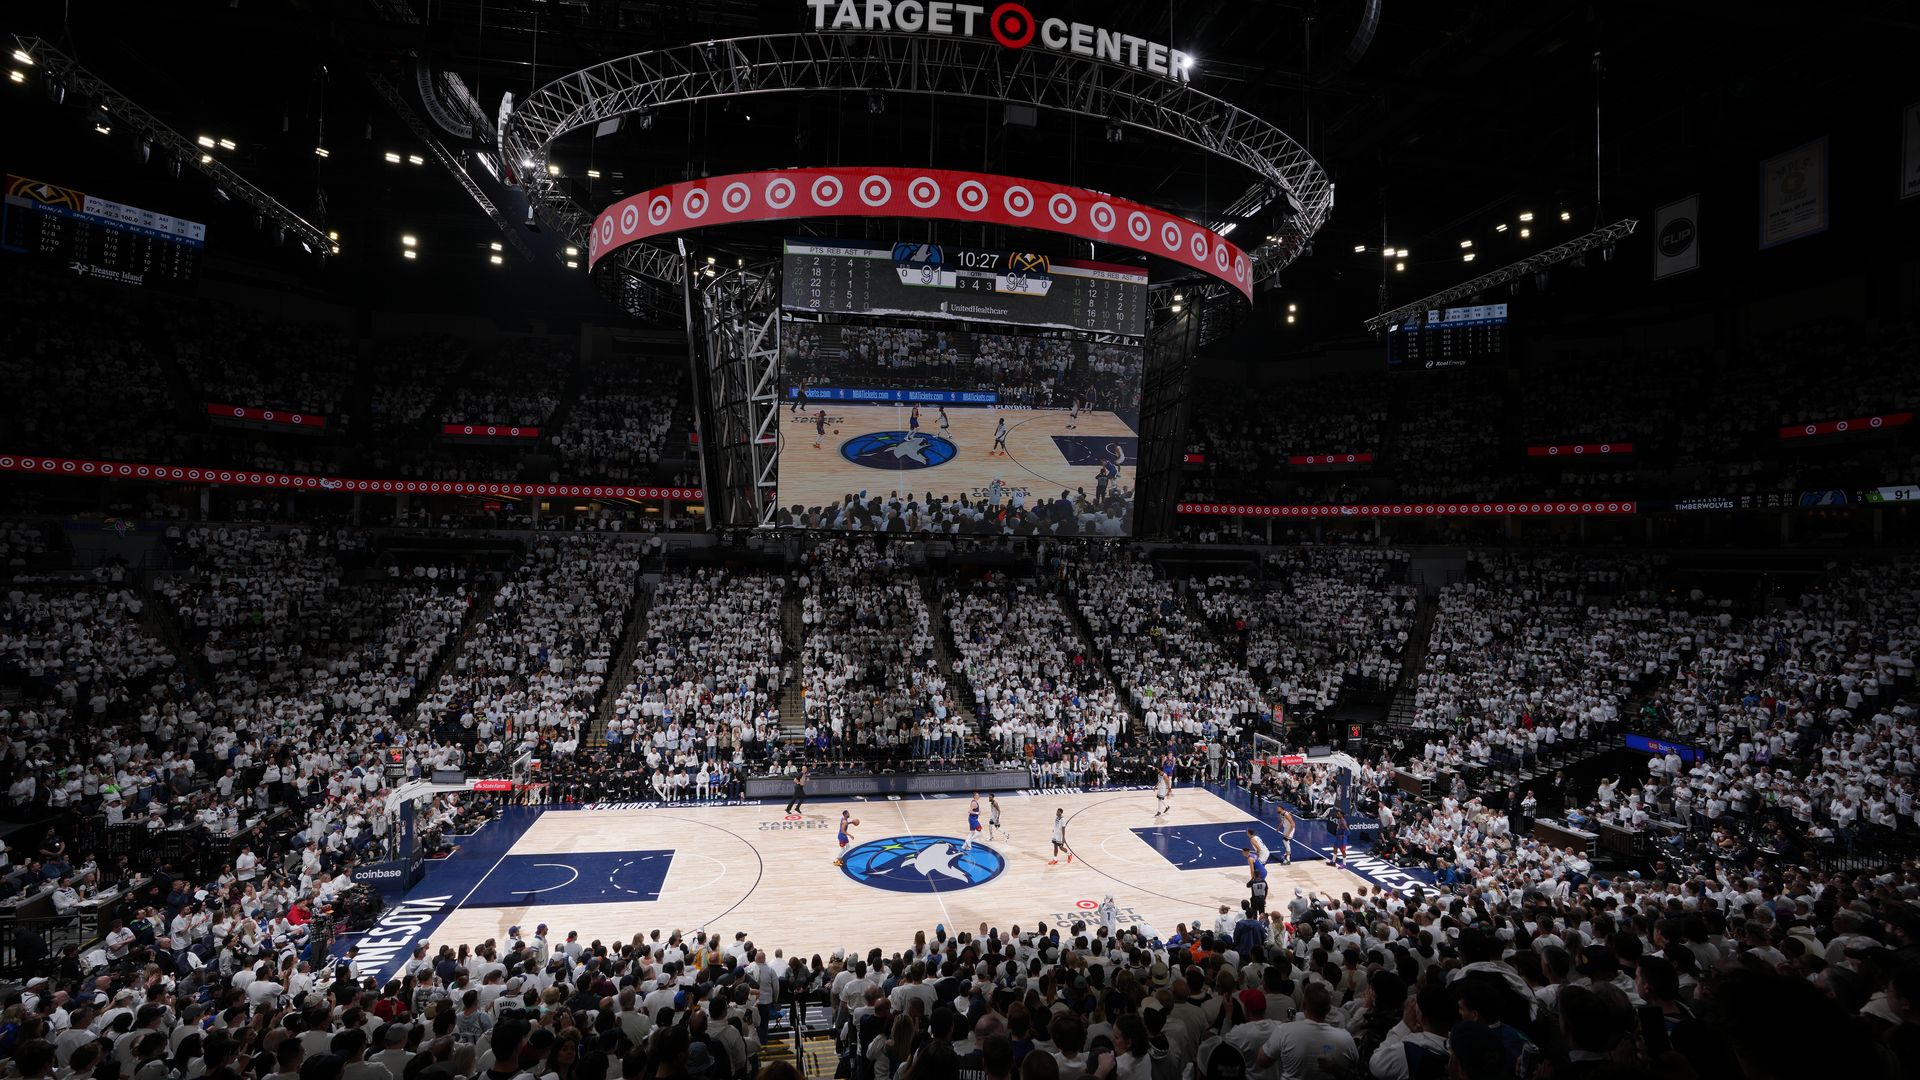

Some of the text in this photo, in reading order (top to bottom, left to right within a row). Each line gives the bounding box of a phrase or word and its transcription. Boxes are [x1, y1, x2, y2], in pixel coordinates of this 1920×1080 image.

[807, 0, 1191, 83] TARGET CENTER
[121, 215, 139, 223] 100.0
[1662, 227, 1691, 247] FLIP
[814, 257, 820, 266] 2
[830, 258, 836, 266] 2
[848, 259, 853, 267] 4
[864, 260, 871, 268] 3
[958, 251, 1000, 269] 10:27
[90, 264, 120, 278] Treasure
[122, 271, 143, 282] Island
[811, 268, 821, 277] 18
[831, 269, 836, 277] 7
[849, 270, 853, 278] 1
[864, 271, 870, 279] 3
[921, 264, 942, 285] 91
[810, 279, 821, 287] 22
[830, 279, 836, 287] 6
[960, 280, 992, 291] 3 4 3
[1006, 272, 1029, 292] 94
[1090, 280, 1095, 288] 3
[1120, 283, 1123, 291] 1
[812, 289, 821, 297] 10
[830, 290, 835, 298] 2
[847, 291, 853, 299] 5
[864, 292, 869, 300] 3
[1088, 290, 1097, 298] 12
[1118, 293, 1123, 301] 2
[1132, 295, 1137, 303] 2
[809, 300, 821, 308] 28
[846, 301, 852, 309] 4
[950, 304, 1008, 316] UnitedHealthcare
[1102, 311, 1110, 319] 10
[1116, 313, 1124, 321] 10
[1118, 322, 1121, 330] 1
[852, 389, 889, 399] NBATickets.com
[909, 391, 943, 400] NBATickets.com
[963, 392, 996, 402] NBATickets.com
[1895, 490, 1910, 500] 91
[1674, 501, 1734, 511] TIMBERWOLVES
[1028, 787, 1083, 796] PLAYOFFS
[595, 802, 660, 810] PLAYOFFS
[1349, 822, 1379, 830] coinbase
[355, 869, 402, 879] coinbase
[1107, 912, 1110, 920] 1
